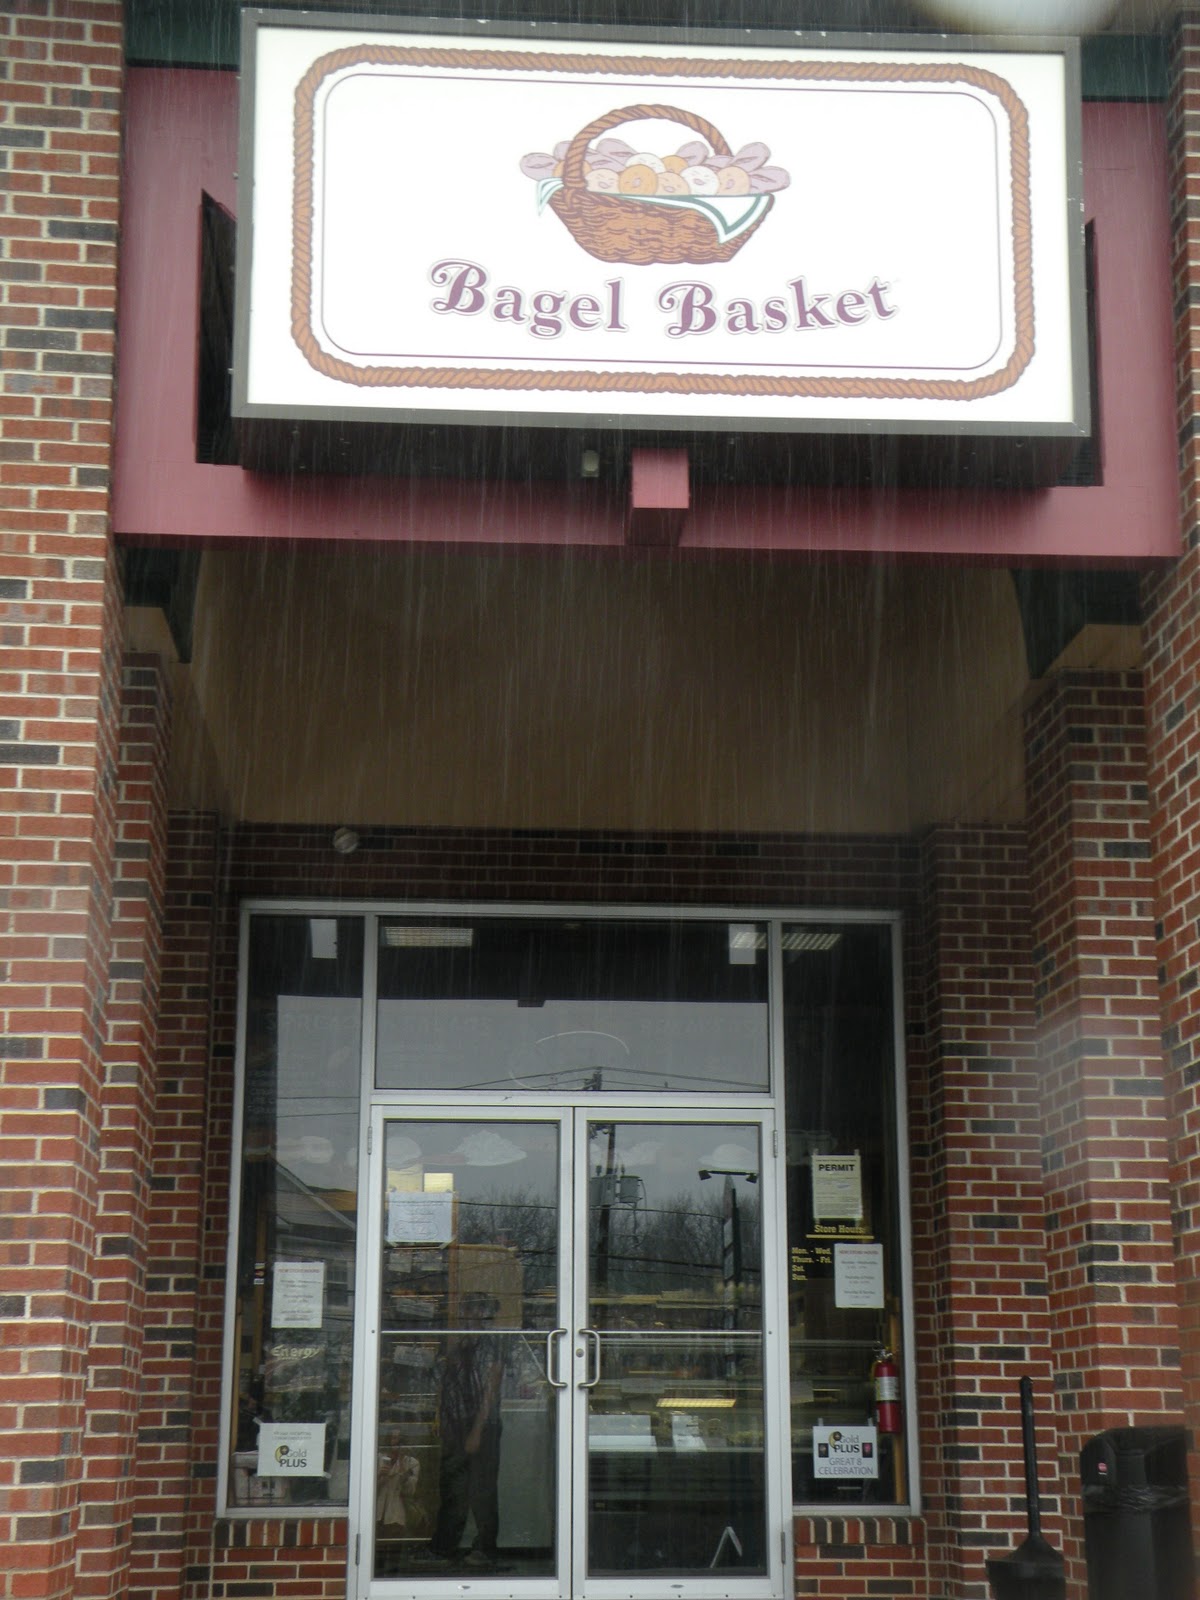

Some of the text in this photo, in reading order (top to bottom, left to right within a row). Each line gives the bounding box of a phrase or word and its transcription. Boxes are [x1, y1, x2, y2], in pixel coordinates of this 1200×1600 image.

[430, 259, 898, 338] Bagel Basket
[814, 1224, 837, 1233] Store
[271, 1344, 320, 1359] Energy
[834, 1444, 860, 1453] PLUS
[279, 1457, 307, 1468] PLUS
[829, 1457, 855, 1466] GREAT
[819, 1467, 873, 1475] CELEBRATION
